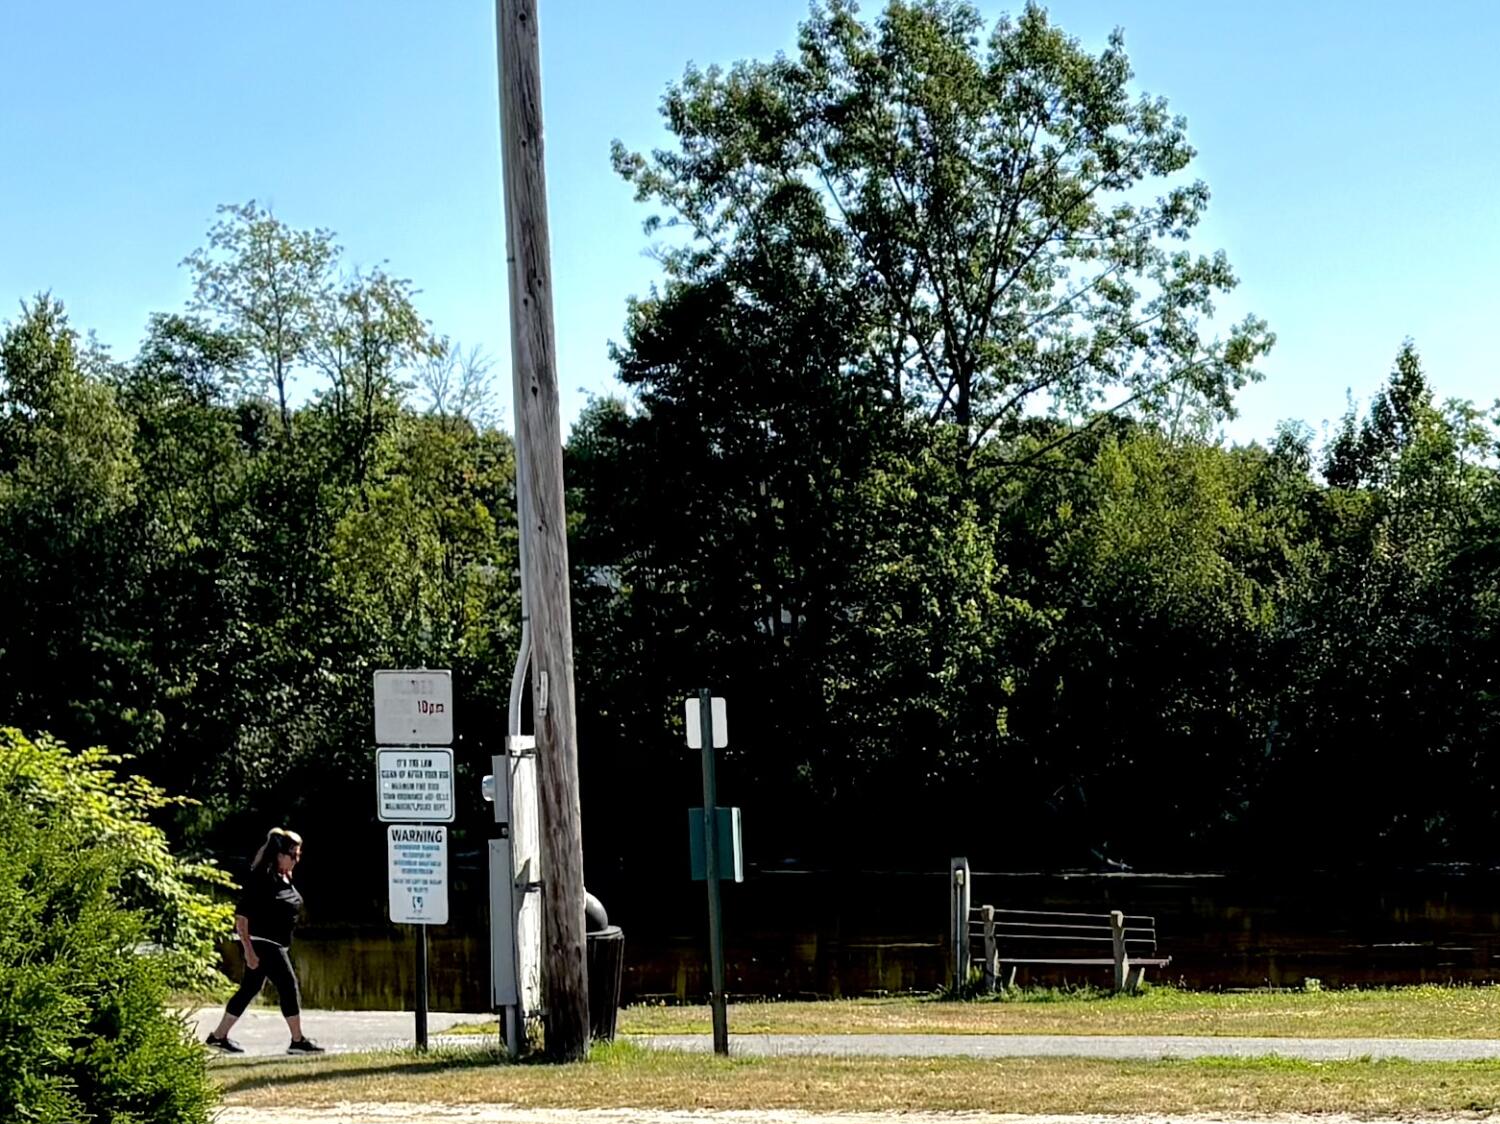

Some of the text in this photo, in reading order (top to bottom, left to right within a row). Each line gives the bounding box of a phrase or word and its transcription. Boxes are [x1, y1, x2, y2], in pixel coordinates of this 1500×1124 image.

[417, 700, 444, 716] 10pm
[382, 770, 397, 778] CLEAN
[399, 770, 405, 778] UP
[408, 770, 423, 778] AFTER
[440, 771, 449, 779] DOG
[391, 829, 443, 843] WARNING
